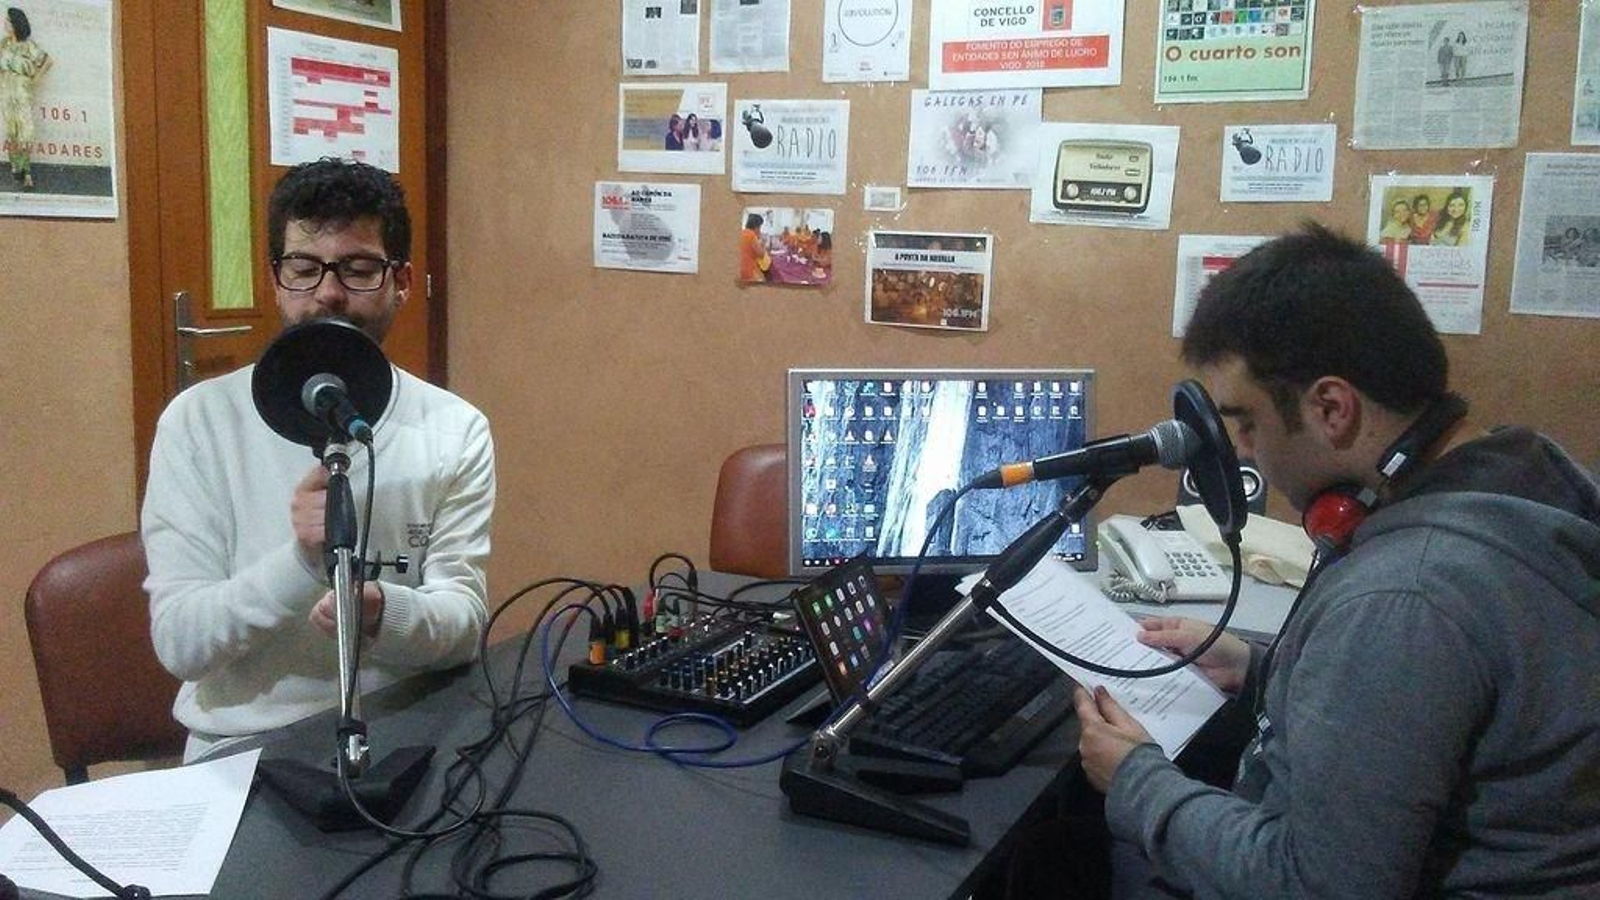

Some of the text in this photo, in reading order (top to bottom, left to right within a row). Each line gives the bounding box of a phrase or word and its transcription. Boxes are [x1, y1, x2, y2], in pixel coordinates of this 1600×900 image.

[974, 6, 1035, 18] CONCELLO
[980, 17, 1027, 27] DE VIGO
[966, 38, 1083, 50] FOMENTO DO EMPREGO DE
[952, 51, 999, 61] ENTIDADES
[1001, 50, 1019, 60] SEN
[1051, 48, 1063, 58] DE
[1065, 47, 1097, 58] LUCRO
[1165, 44, 1302, 62] O cuarto son
[1000, 61, 1021, 69] VIGO
[924, 96, 983, 107] GALEGAS
[990, 95, 1005, 106] EN
[40, 107, 87, 123] 106.1
[777, 125, 837, 159] RADIO
[1264, 144, 1324, 173] RADIO
